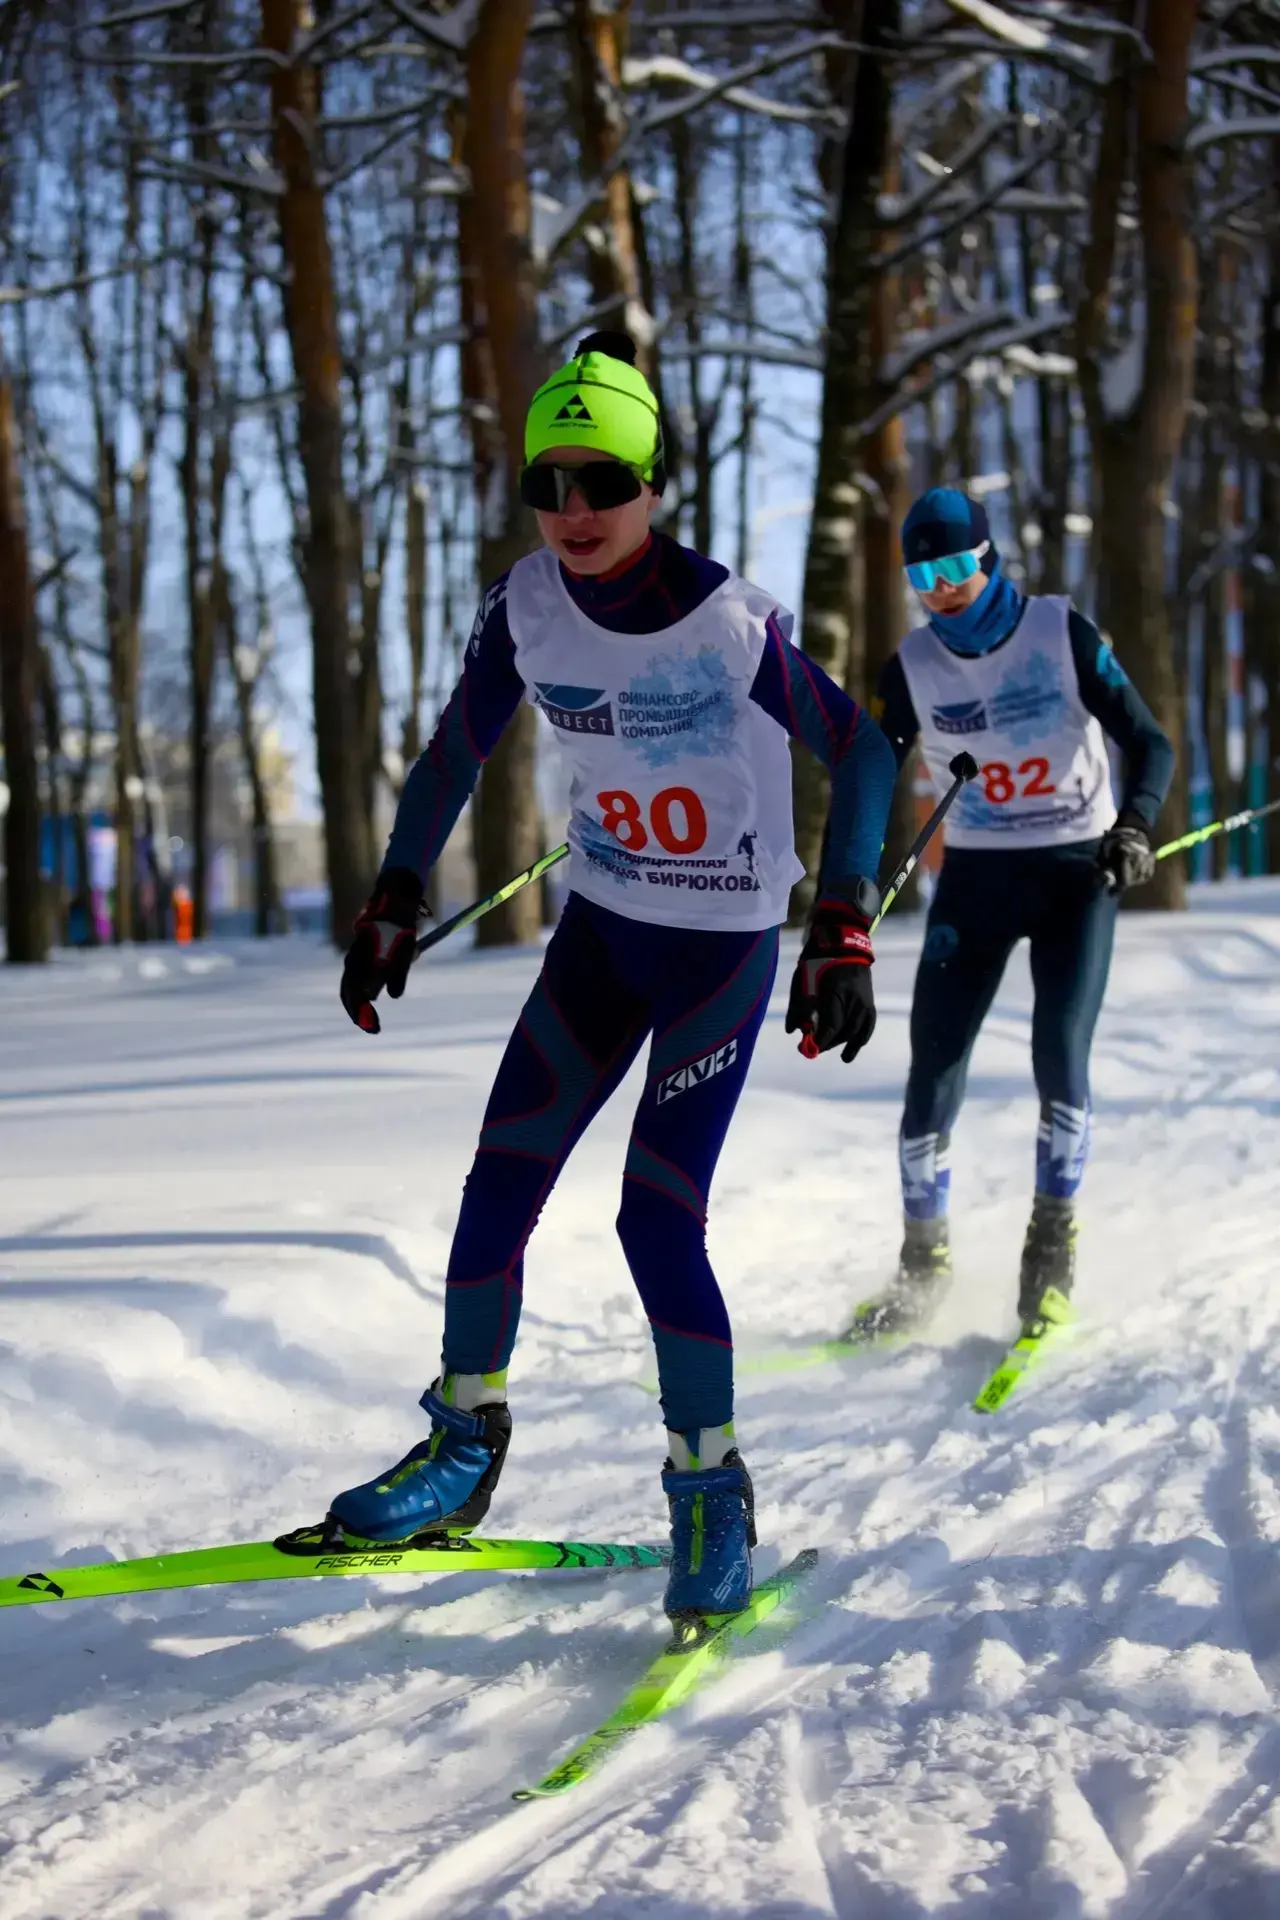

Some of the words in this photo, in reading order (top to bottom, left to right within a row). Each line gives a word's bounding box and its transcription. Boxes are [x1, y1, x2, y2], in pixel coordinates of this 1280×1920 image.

[621, 718, 693, 739] КОМПАНИЯ
[980, 757, 1056, 804] 82
[597, 787, 707, 854] 80
[315, 1555, 403, 1570] FISCHER
